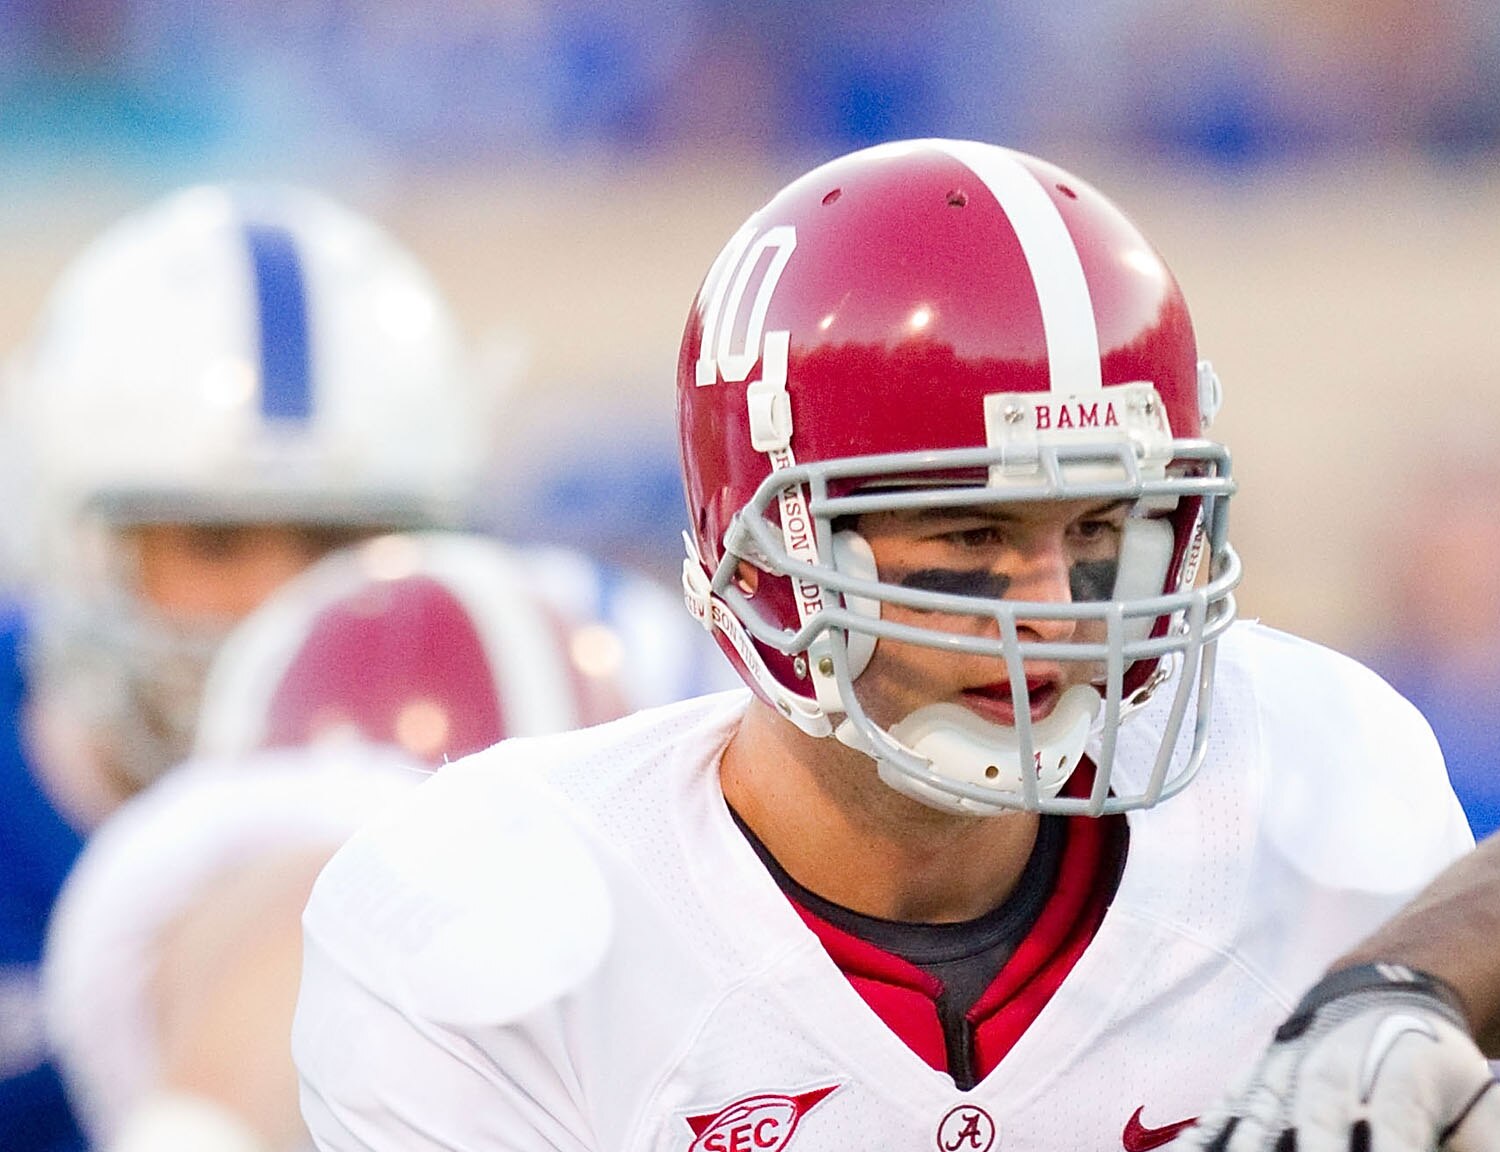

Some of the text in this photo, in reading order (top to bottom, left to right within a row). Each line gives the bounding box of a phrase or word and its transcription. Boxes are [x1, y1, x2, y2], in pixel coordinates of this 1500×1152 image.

[695, 222, 798, 388] 10
[1035, 402, 1119, 430] BAMA
[945, 1113, 983, 1152] A
